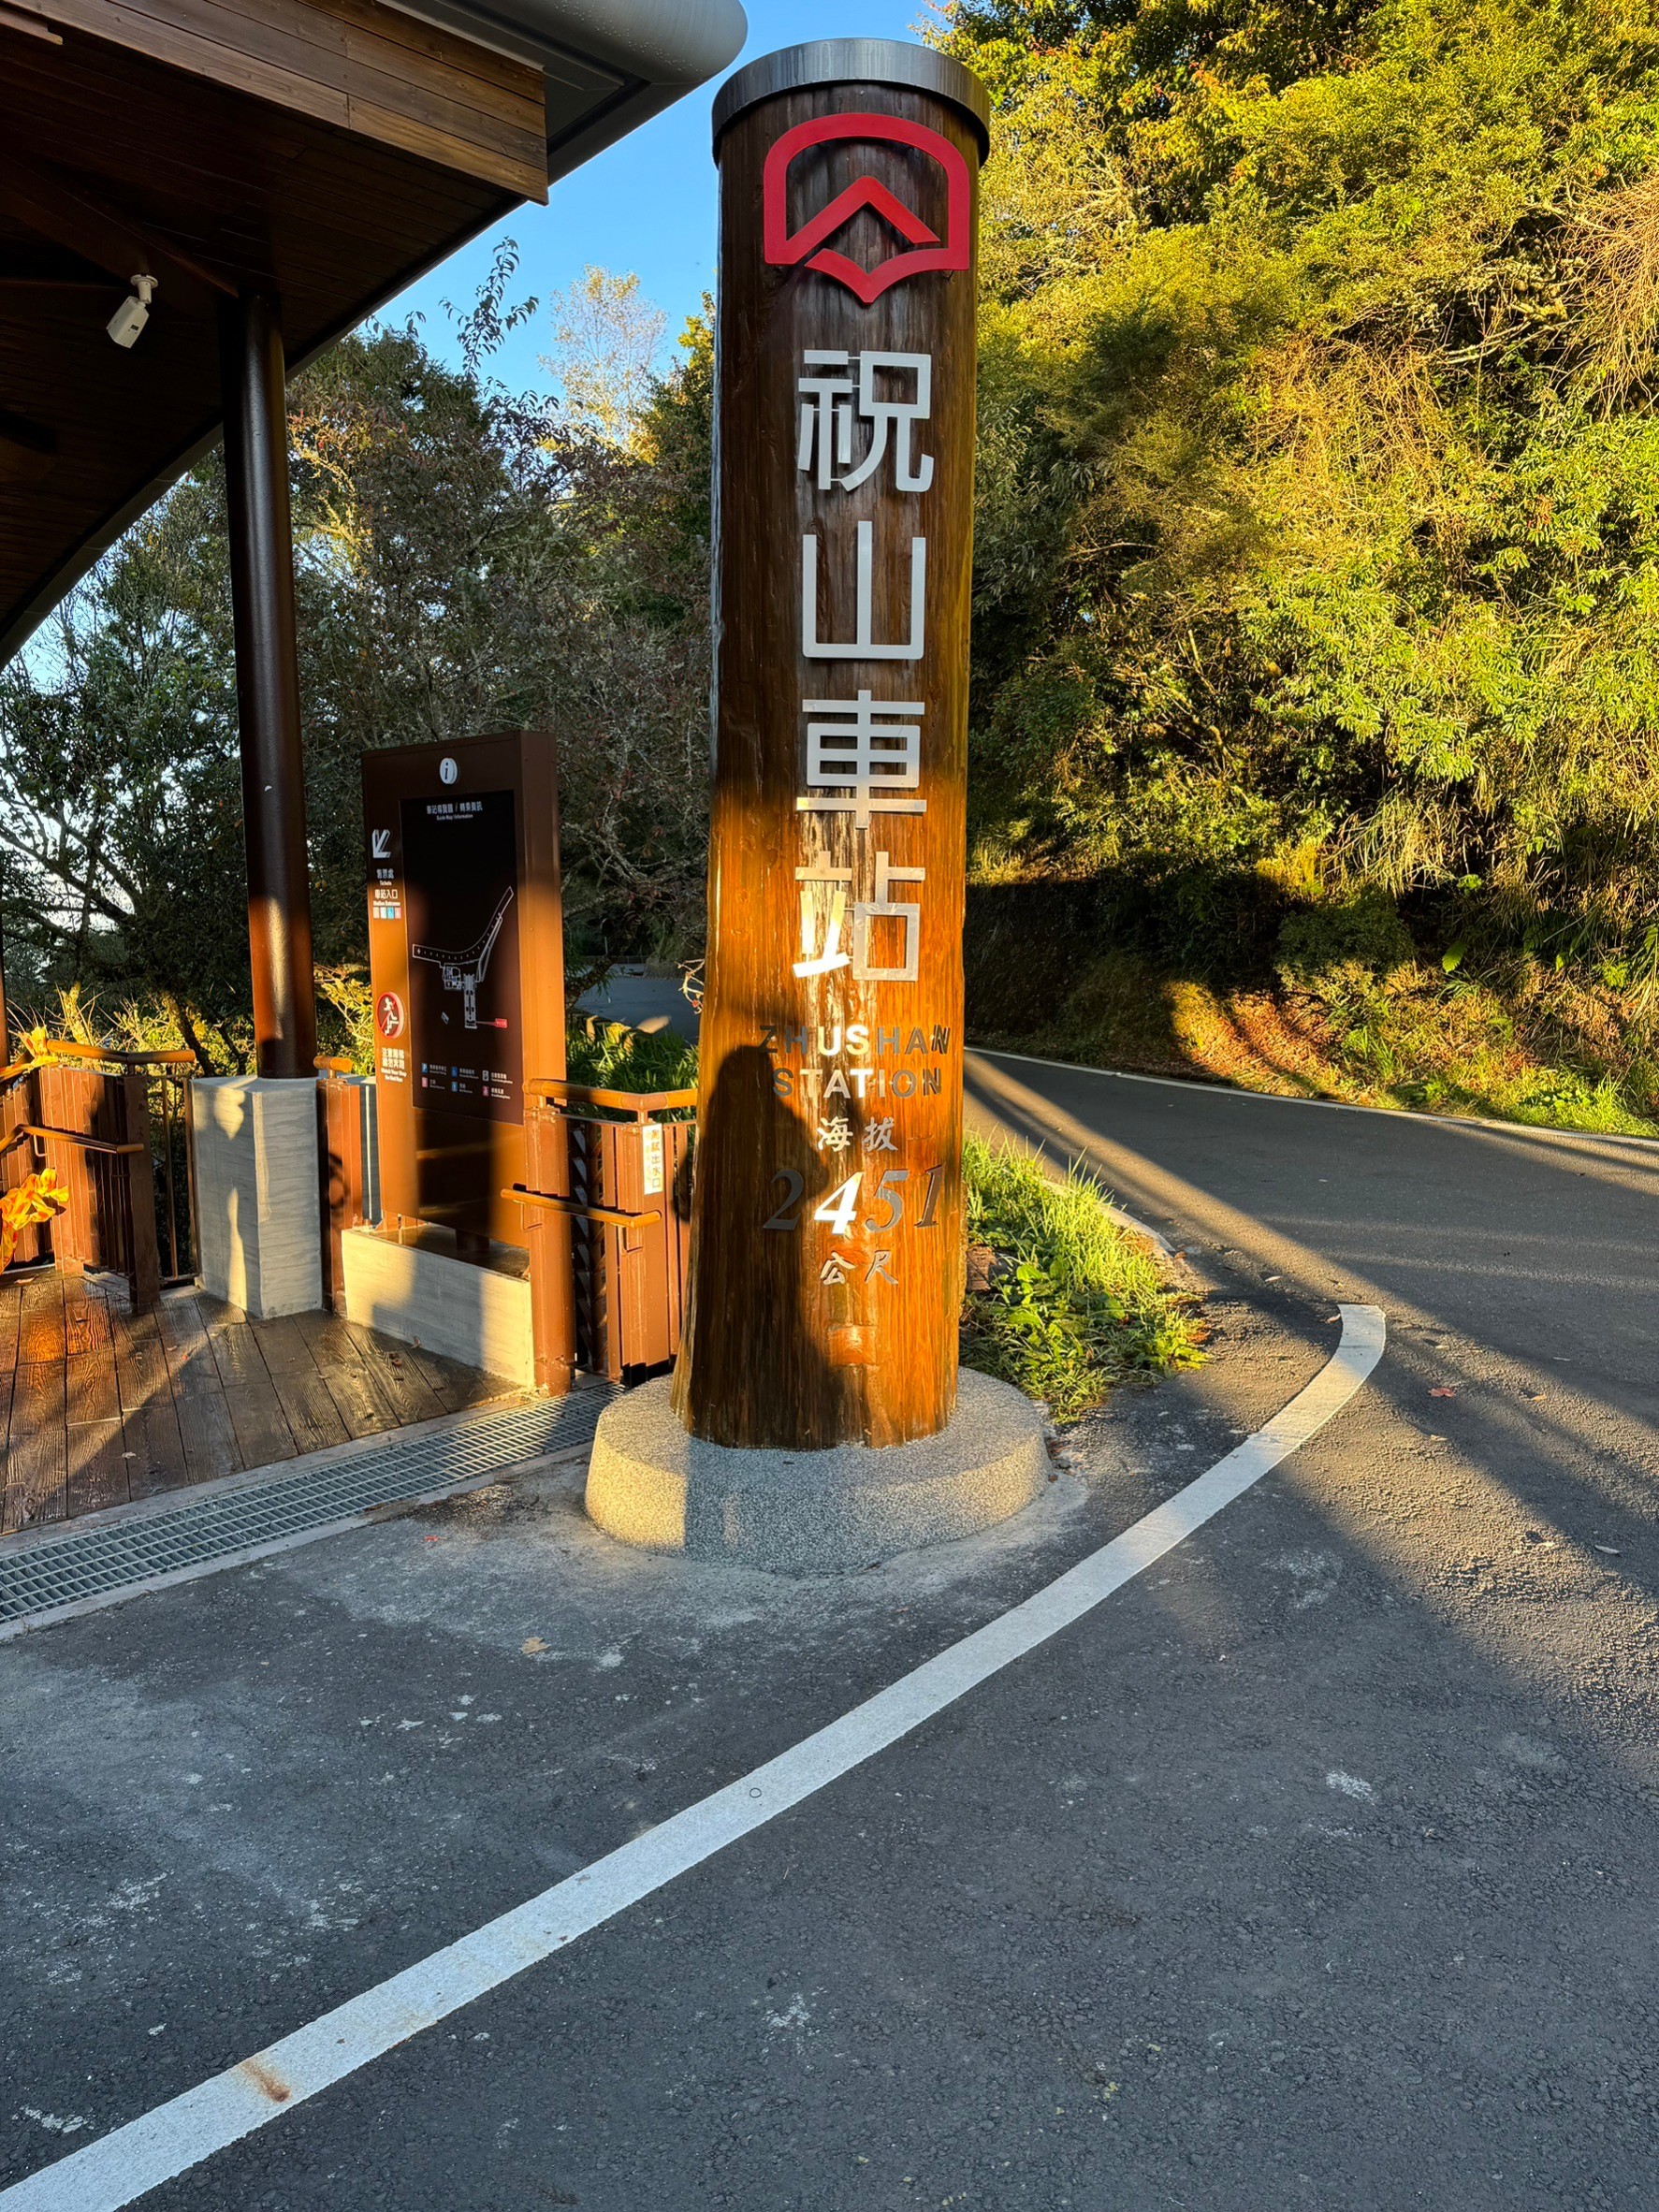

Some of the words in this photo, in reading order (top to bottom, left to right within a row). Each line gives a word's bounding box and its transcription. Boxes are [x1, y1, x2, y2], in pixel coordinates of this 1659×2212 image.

[793, 349, 933, 982] 祝山車站
[375, 889, 399, 899] 車站入口
[758, 1025, 951, 1056] ZHUSHAN
[773, 1068, 942, 1099] STATION
[817, 1115, 898, 1152] 海拔
[763, 1164, 946, 1235] 2451
[820, 1249, 899, 1286] 公尺
